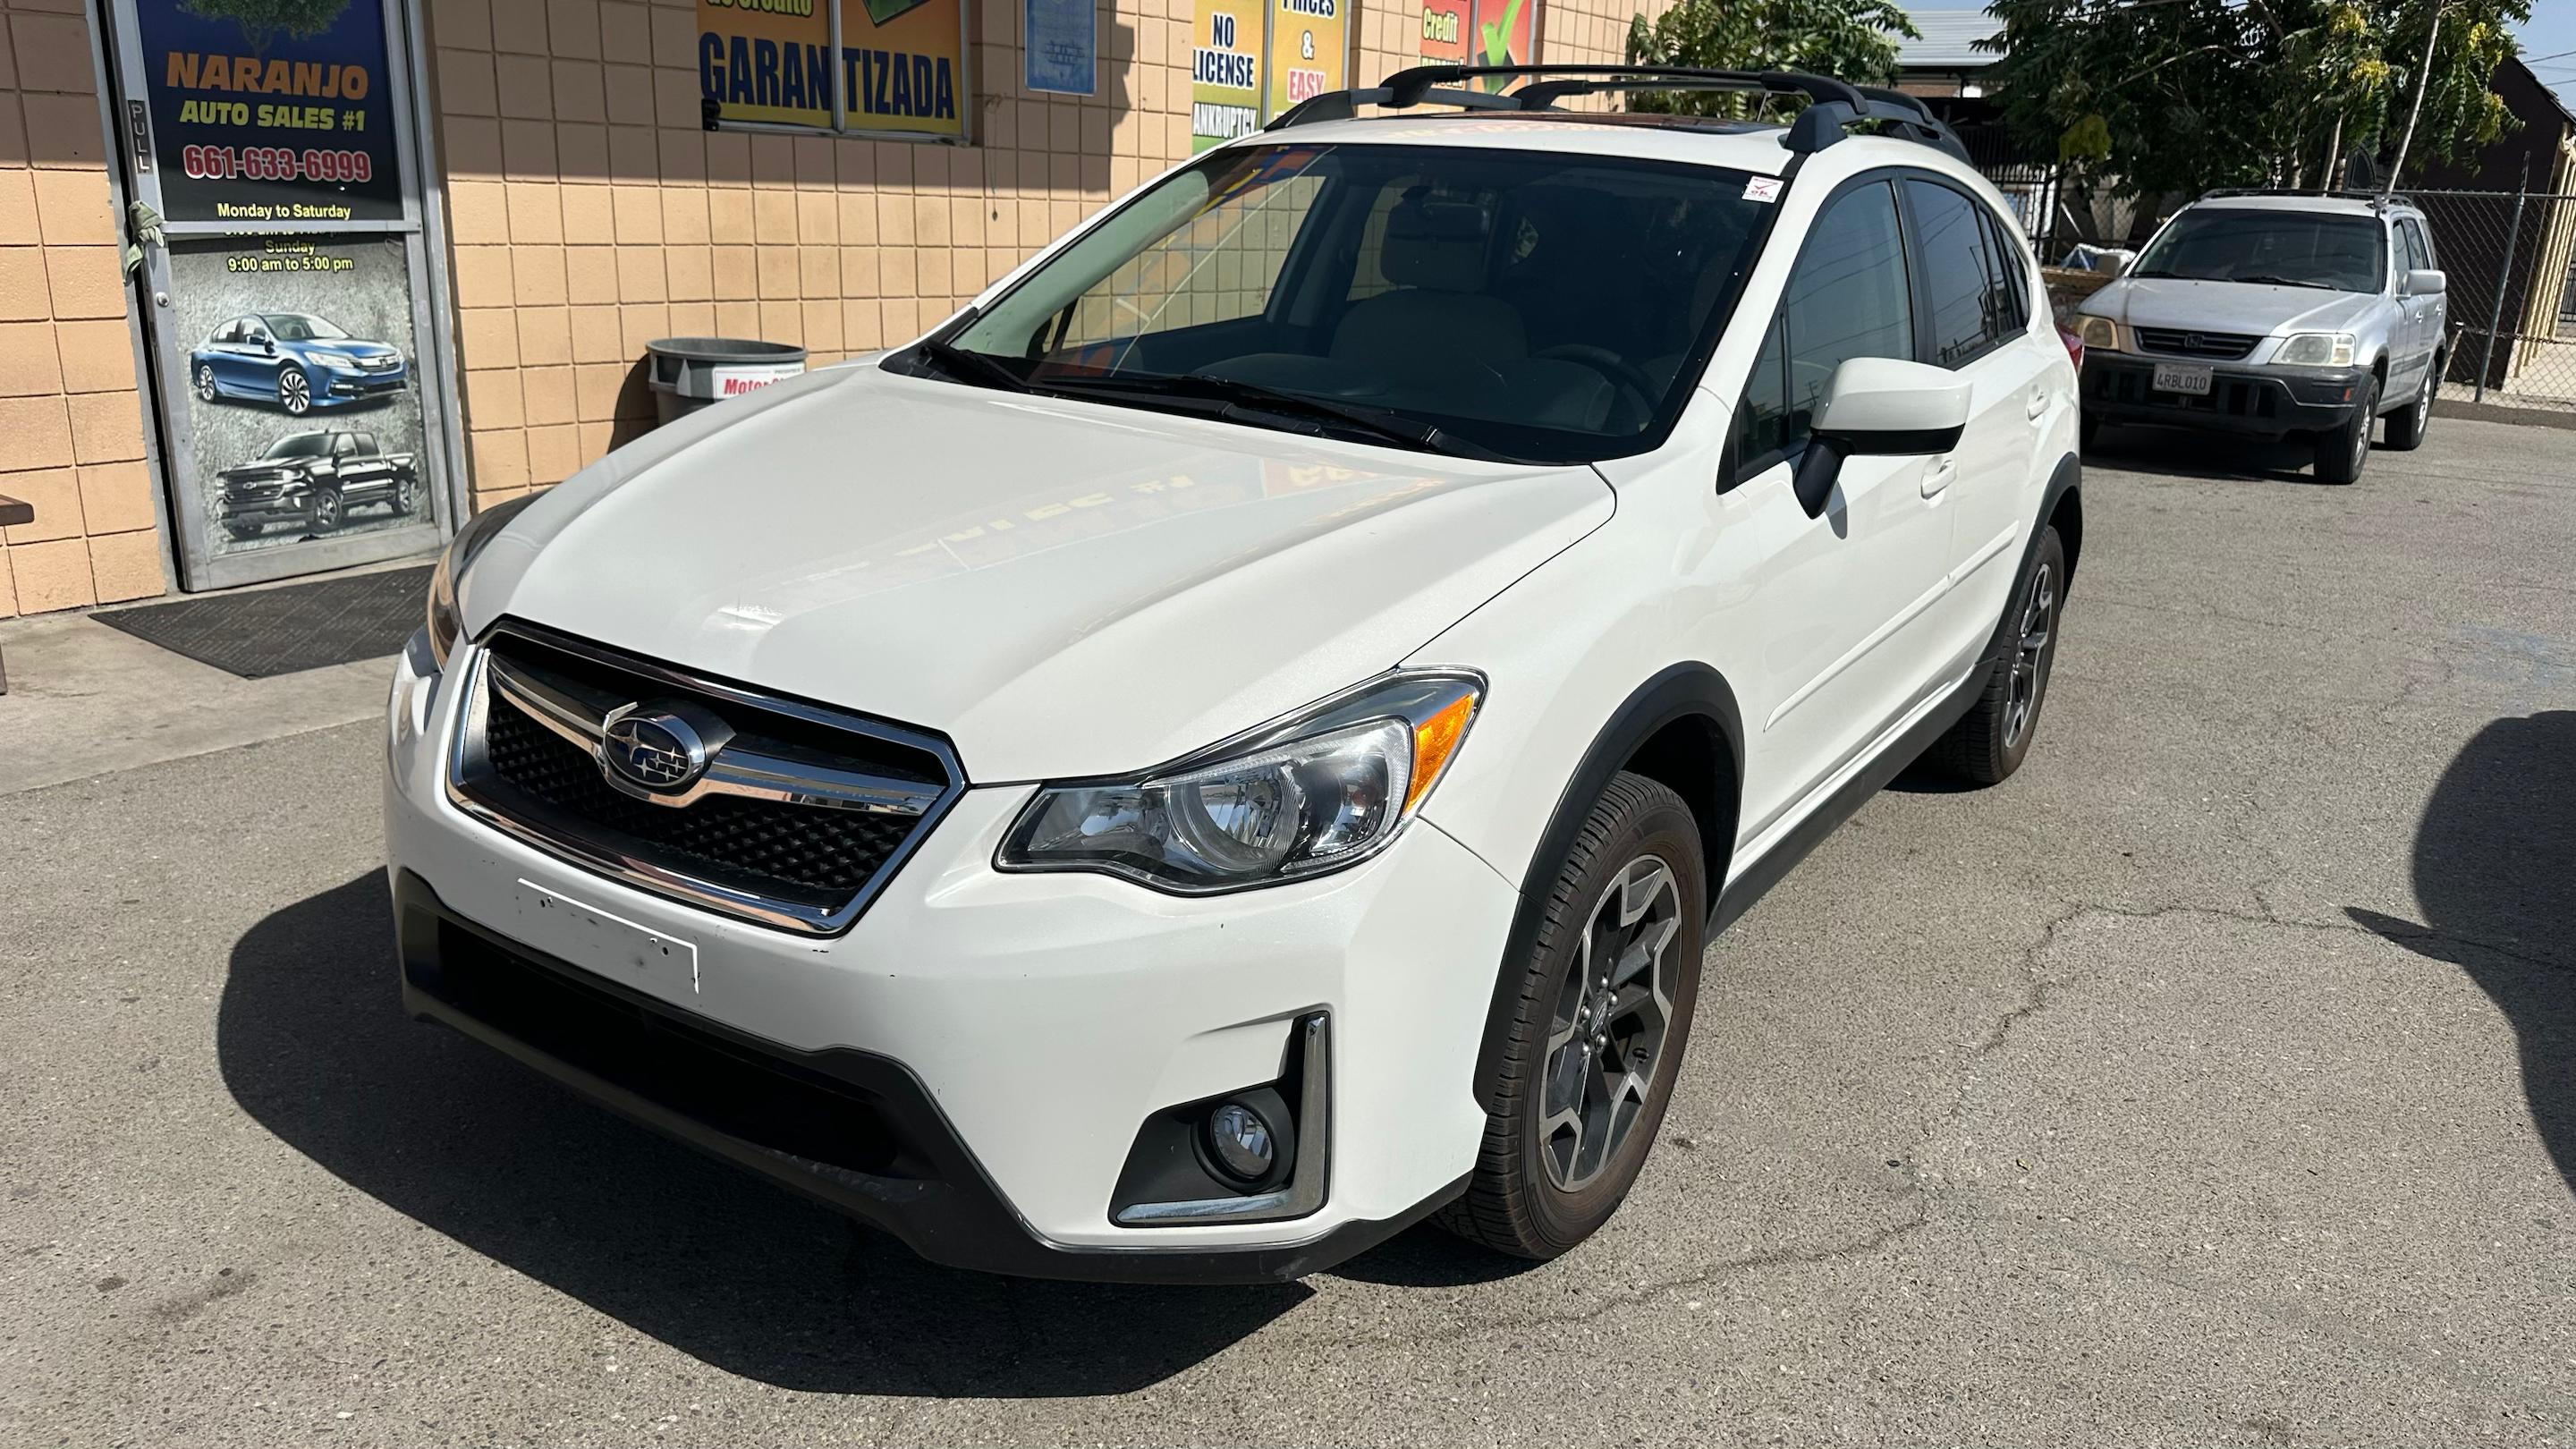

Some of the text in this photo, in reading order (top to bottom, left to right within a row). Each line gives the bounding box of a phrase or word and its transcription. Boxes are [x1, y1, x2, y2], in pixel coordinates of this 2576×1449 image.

[1213, 14, 1234, 47] NO
[1422, 6, 1459, 44] Credit
[1301, 30, 1315, 60] &
[166, 52, 369, 100] NARANJO
[699, 32, 955, 120] GARANTIZADA
[1192, 49, 1254, 87] LICENSE
[1289, 71, 1325, 101] EASY
[180, 100, 366, 131] AUTO SALES #1
[1193, 103, 1258, 139] ANKRUPTCY
[131, 105, 149, 169] PULL
[183, 145, 371, 182] 661-633-6999
[217, 203, 351, 220] Monday to Saturday
[228, 257, 352, 272] 9:00 am to 5:00 pm
[266, 240, 315, 255] Sunday
